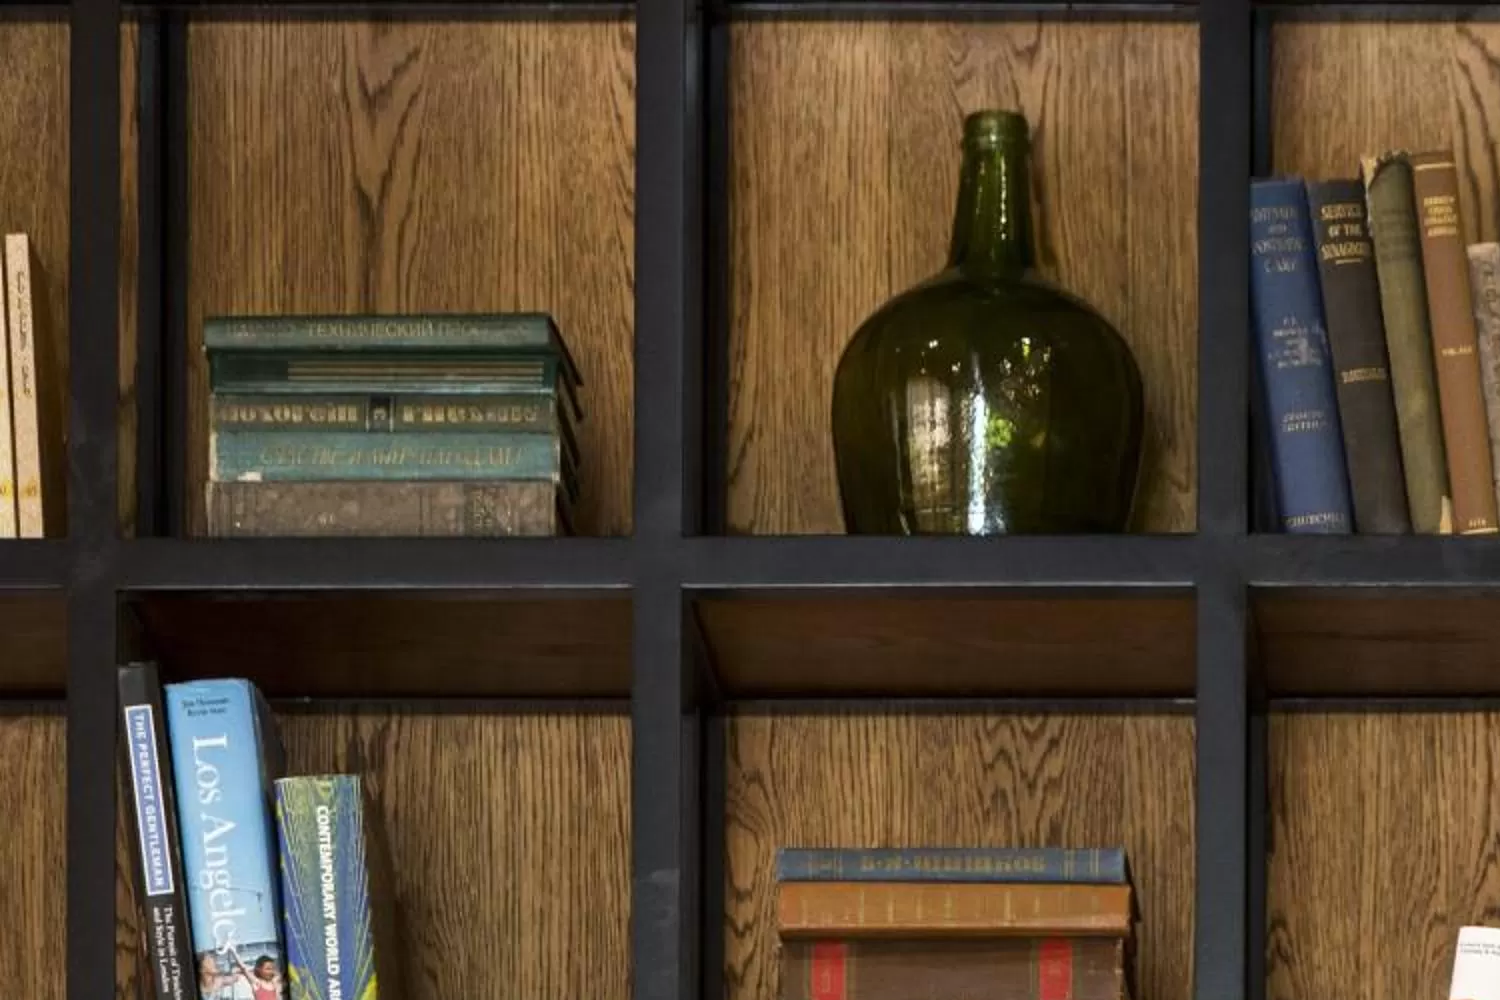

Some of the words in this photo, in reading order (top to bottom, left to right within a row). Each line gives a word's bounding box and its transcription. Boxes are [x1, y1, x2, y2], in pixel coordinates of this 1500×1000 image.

[134, 714, 147, 740] THE
[139, 743, 155, 801] PERFECT
[193, 732, 228, 805] Los
[145, 805, 165, 888] GENTLEMAN
[316, 805, 337, 921] CONTEMPORARY
[200, 812, 245, 955] Angeles
[324, 923, 341, 975] WORLD
